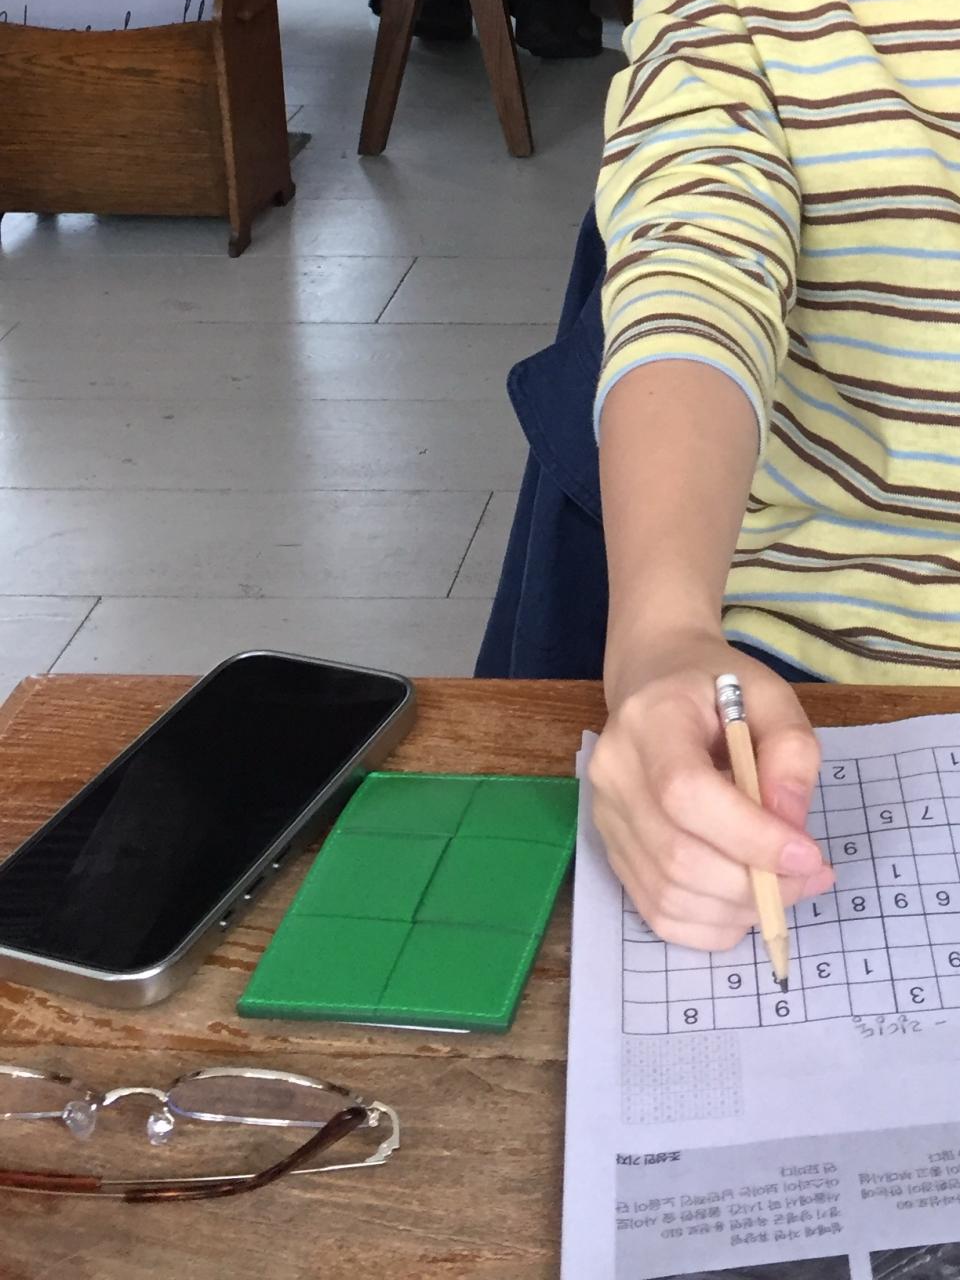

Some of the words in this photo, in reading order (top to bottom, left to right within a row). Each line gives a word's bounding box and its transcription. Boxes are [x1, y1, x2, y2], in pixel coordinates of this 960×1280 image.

[950, 752, 960, 766] 1
[832, 766, 846, 779] 2
[879, 810, 893, 824] 5
[921, 805, 934, 821] 7
[844, 841, 858, 856] 9
[891, 864, 901, 879] 1
[851, 896, 865, 912] 8
[894, 893, 909, 909] 9
[936, 891, 950, 906] 6
[812, 902, 821, 917] 1
[816, 962, 831, 978] 3
[864, 959, 873, 975] 1
[727, 973, 742, 989] 6
[910, 986, 925, 1004] 3
[683, 1008, 698, 1025] 8
[775, 1000, 790, 1017] 9
[852, 1015, 921, 1038] 링딩동
[616, 1154, 640, 1166] 기자
